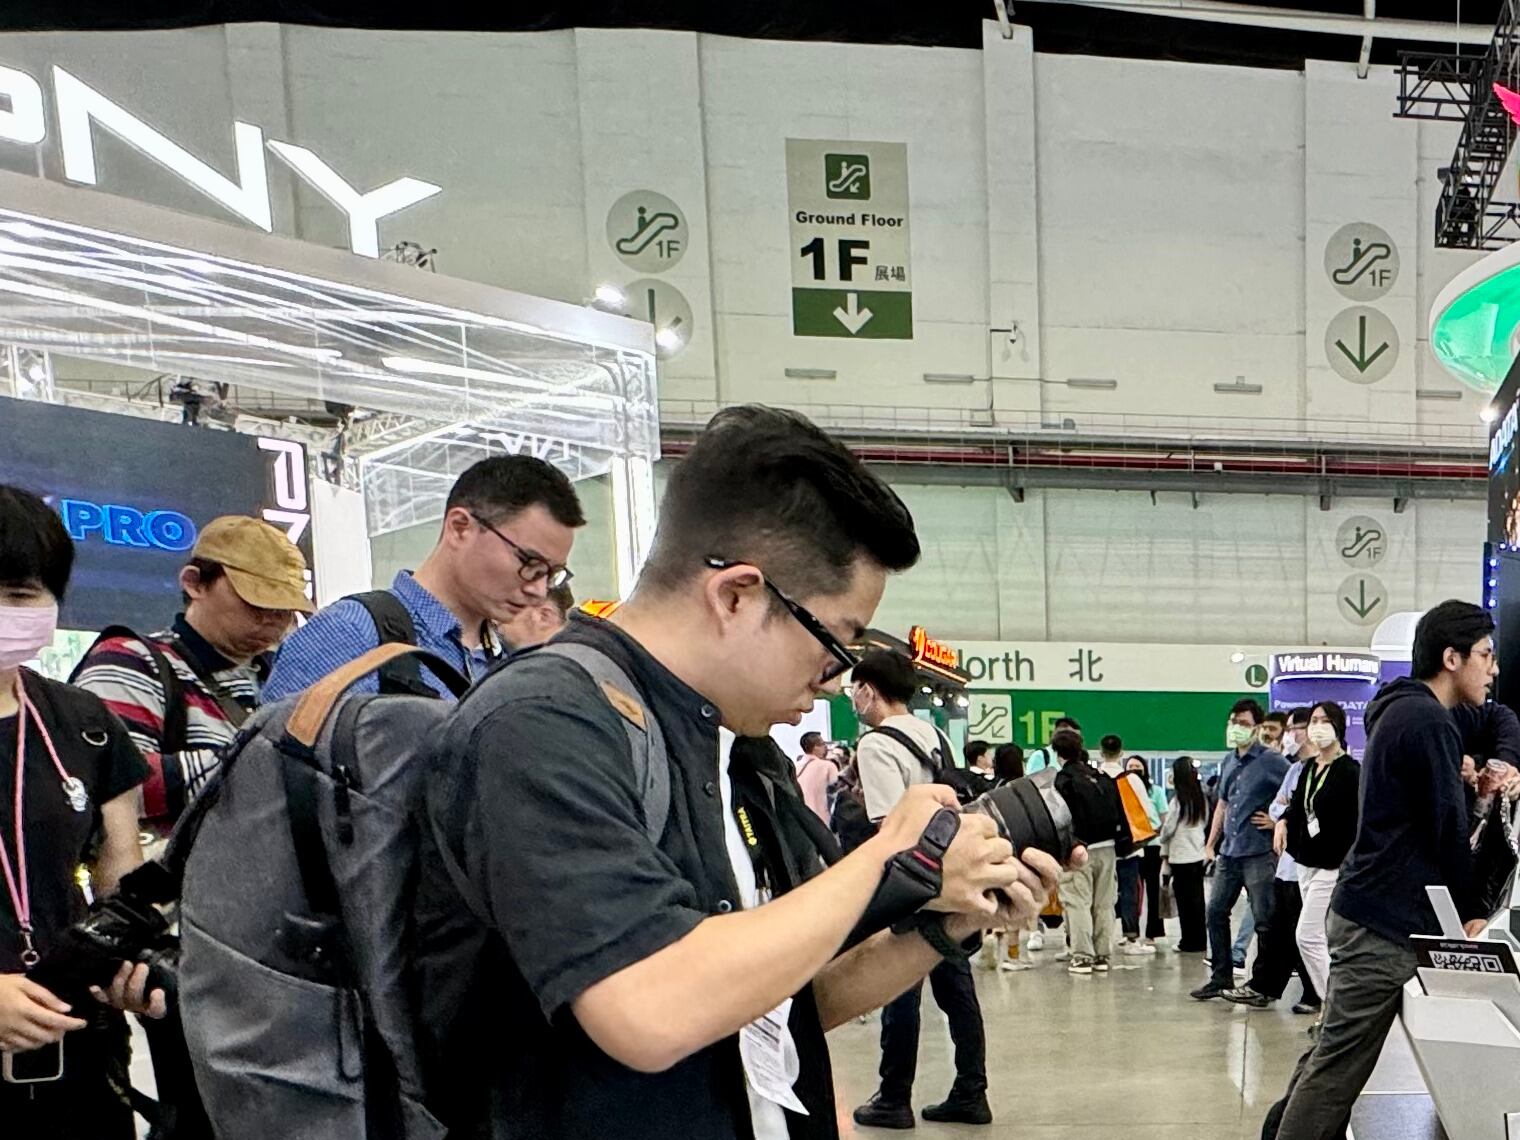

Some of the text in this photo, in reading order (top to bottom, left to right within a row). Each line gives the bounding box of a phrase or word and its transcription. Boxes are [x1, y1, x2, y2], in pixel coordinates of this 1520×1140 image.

[795, 210, 904, 227] Ground Floor
[655, 239, 681, 259] 1F
[800, 237, 906, 281] 1F 展場
[1368, 269, 1392, 287] 1F
[60, 499, 198, 551] PRO
[1067, 648, 1105, 682] 北
[1278, 654, 1324, 673] Virtual
[1019, 710, 1066, 745] 1F
